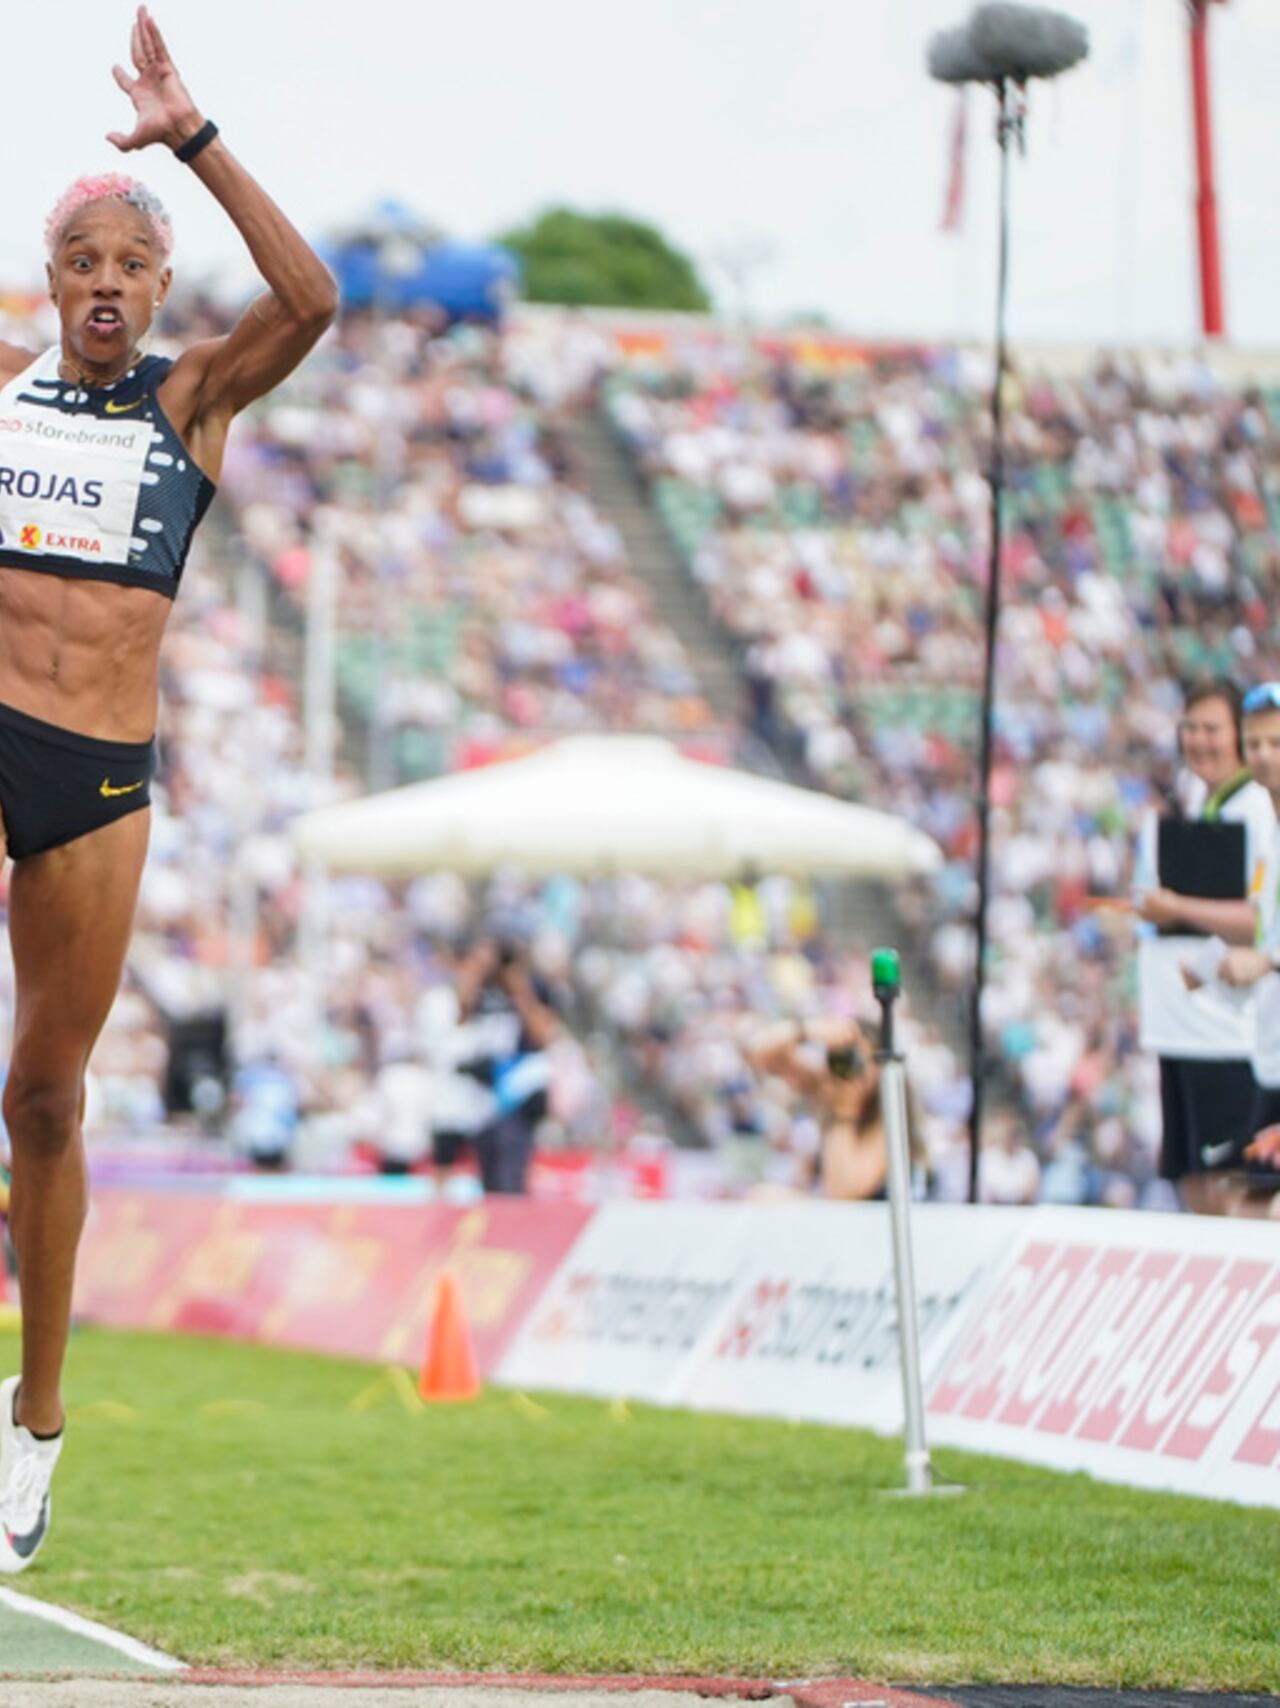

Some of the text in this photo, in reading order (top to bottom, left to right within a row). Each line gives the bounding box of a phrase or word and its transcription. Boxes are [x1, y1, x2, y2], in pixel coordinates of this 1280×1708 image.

[25, 420, 135, 448] storebrand
[45, 533, 100, 553] EXTRA
[927, 1240, 1274, 1462] BAUHAUS
